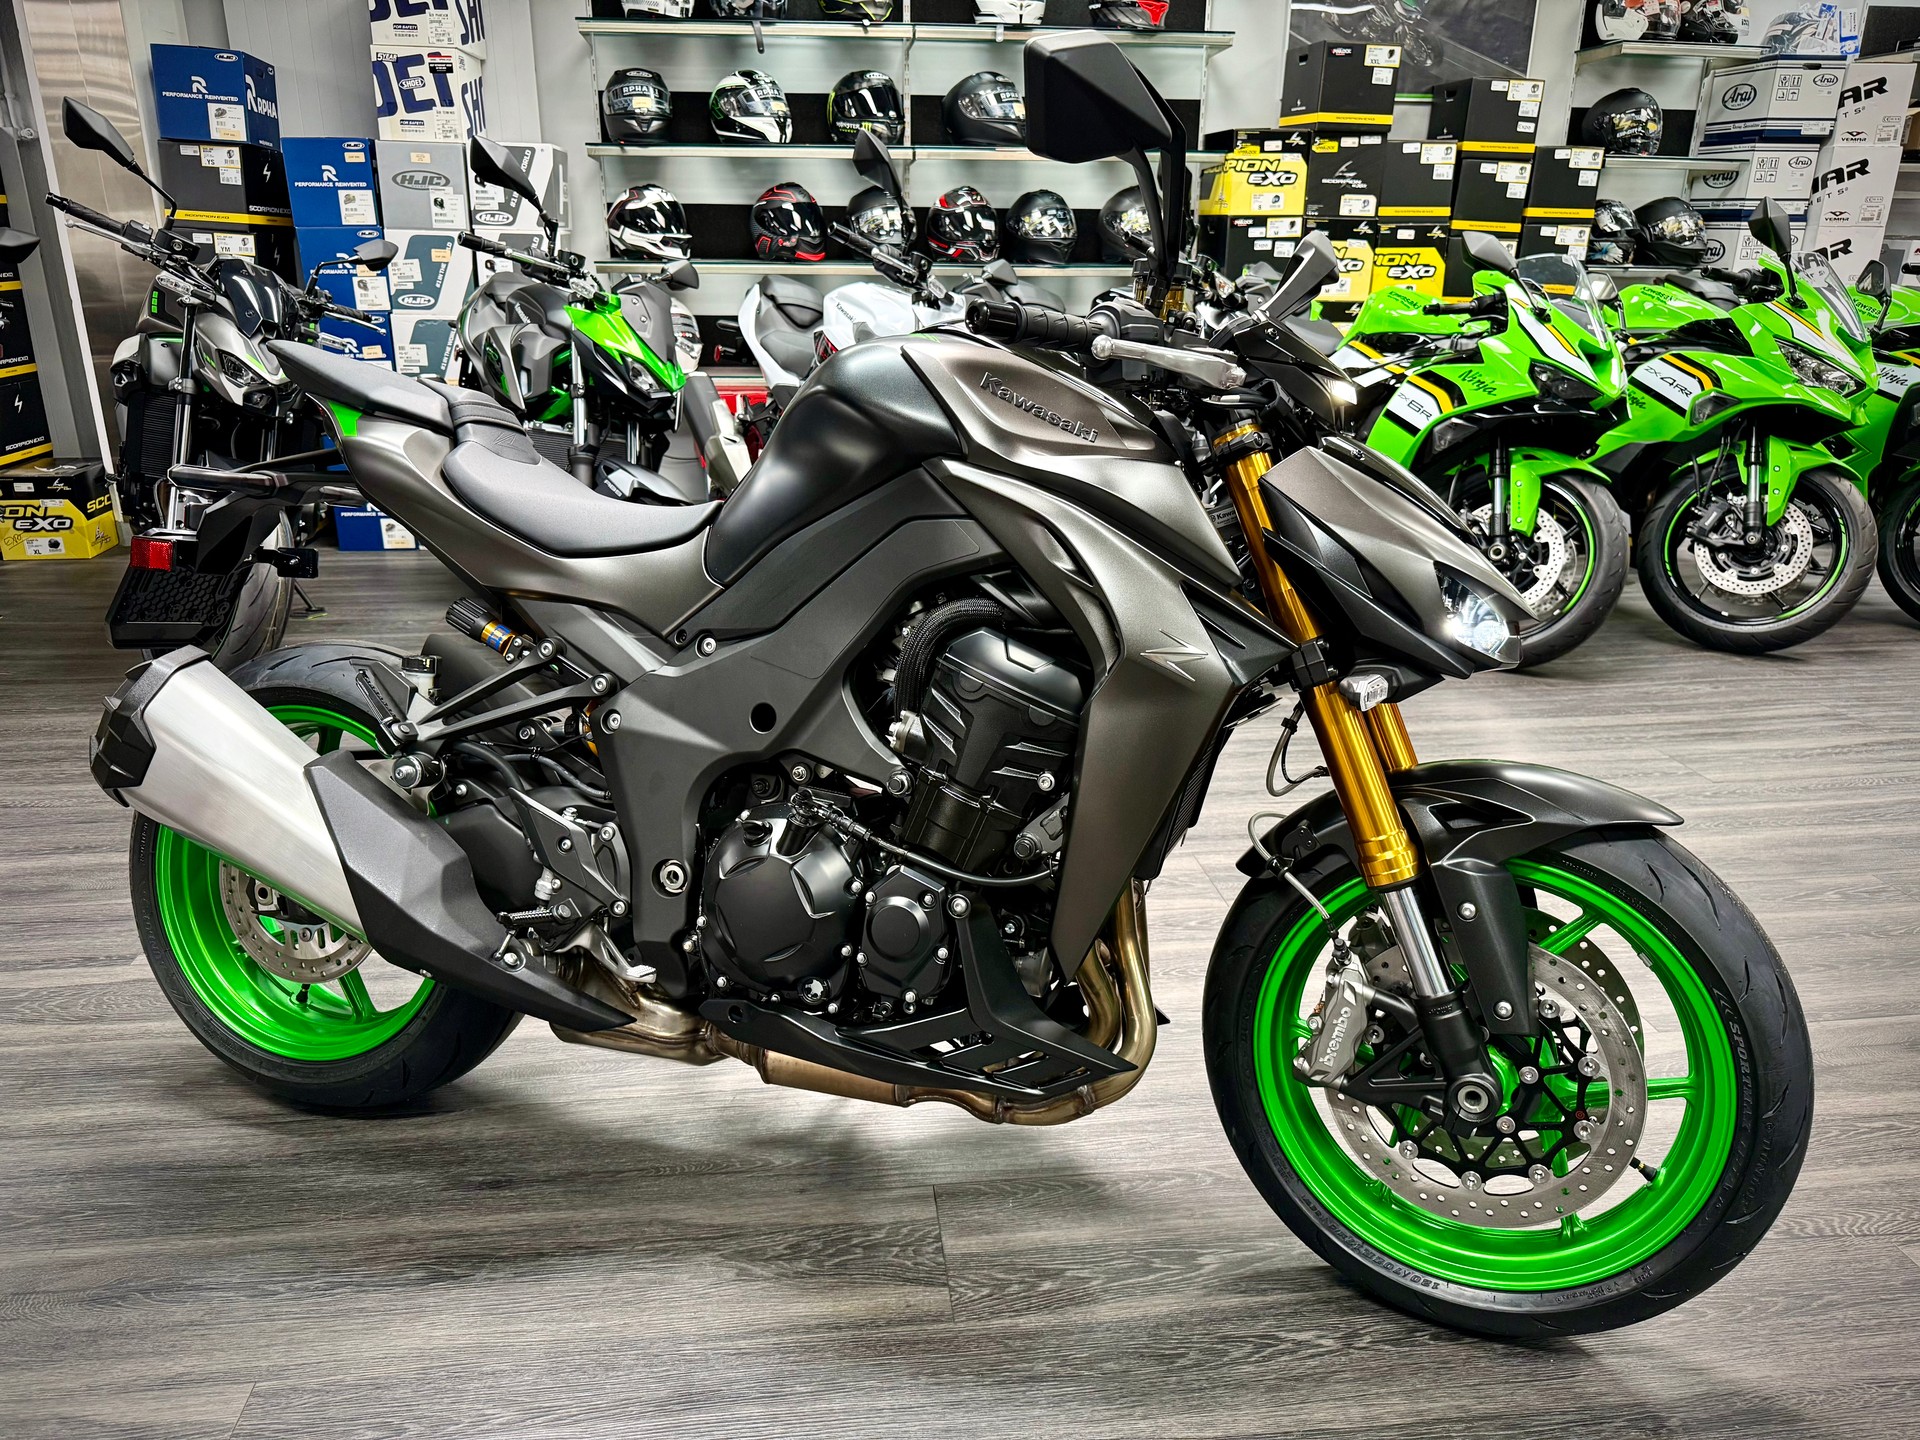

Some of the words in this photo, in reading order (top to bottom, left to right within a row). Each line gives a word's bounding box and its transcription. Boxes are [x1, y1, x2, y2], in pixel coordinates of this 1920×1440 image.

[401, 78, 424, 89] SHOEI
[1816, 74, 1836, 84] Arai
[162, 91, 203, 100] PERFORMANCE
[204, 94, 239, 102] REINVENTED
[1727, 87, 1753, 104] Arai
[399, 174, 443, 186] HJC
[248, 205, 279, 214] SCORPION
[480, 214, 509, 222] HJC
[1458, 369, 1497, 397] Ninja
[980, 372, 1099, 444] Kawasaki
[5, 438, 34, 451] SCORPION
[1319, 1006, 1352, 1067] brembo
